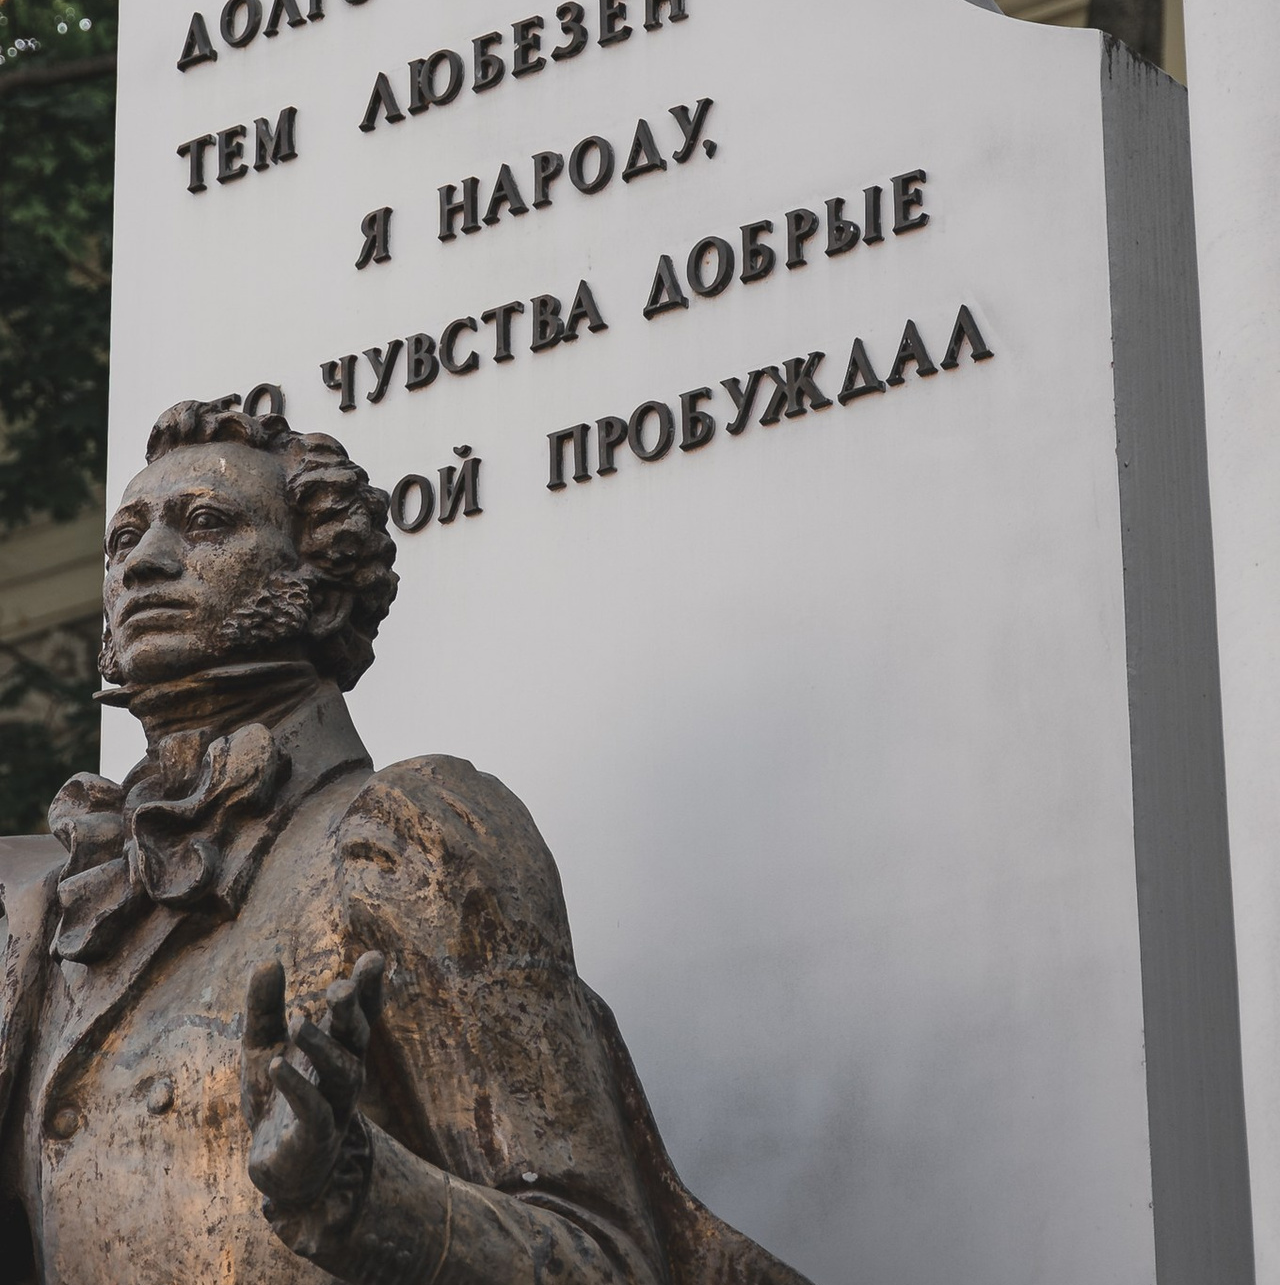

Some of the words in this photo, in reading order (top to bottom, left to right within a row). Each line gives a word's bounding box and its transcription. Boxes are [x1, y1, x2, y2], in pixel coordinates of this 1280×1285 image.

[176, 106, 299, 195] ТЕМ
[354, 206, 394, 271] Я
[437, 97, 719, 244] НАРОДУ,
[319, 279, 609, 414] ЧУВСТВА
[642, 168, 930, 321] ДОБРЫЕ
[389, 444, 484, 534] ОЙ
[546, 304, 995, 492] ПРОБУЖДАЛ
